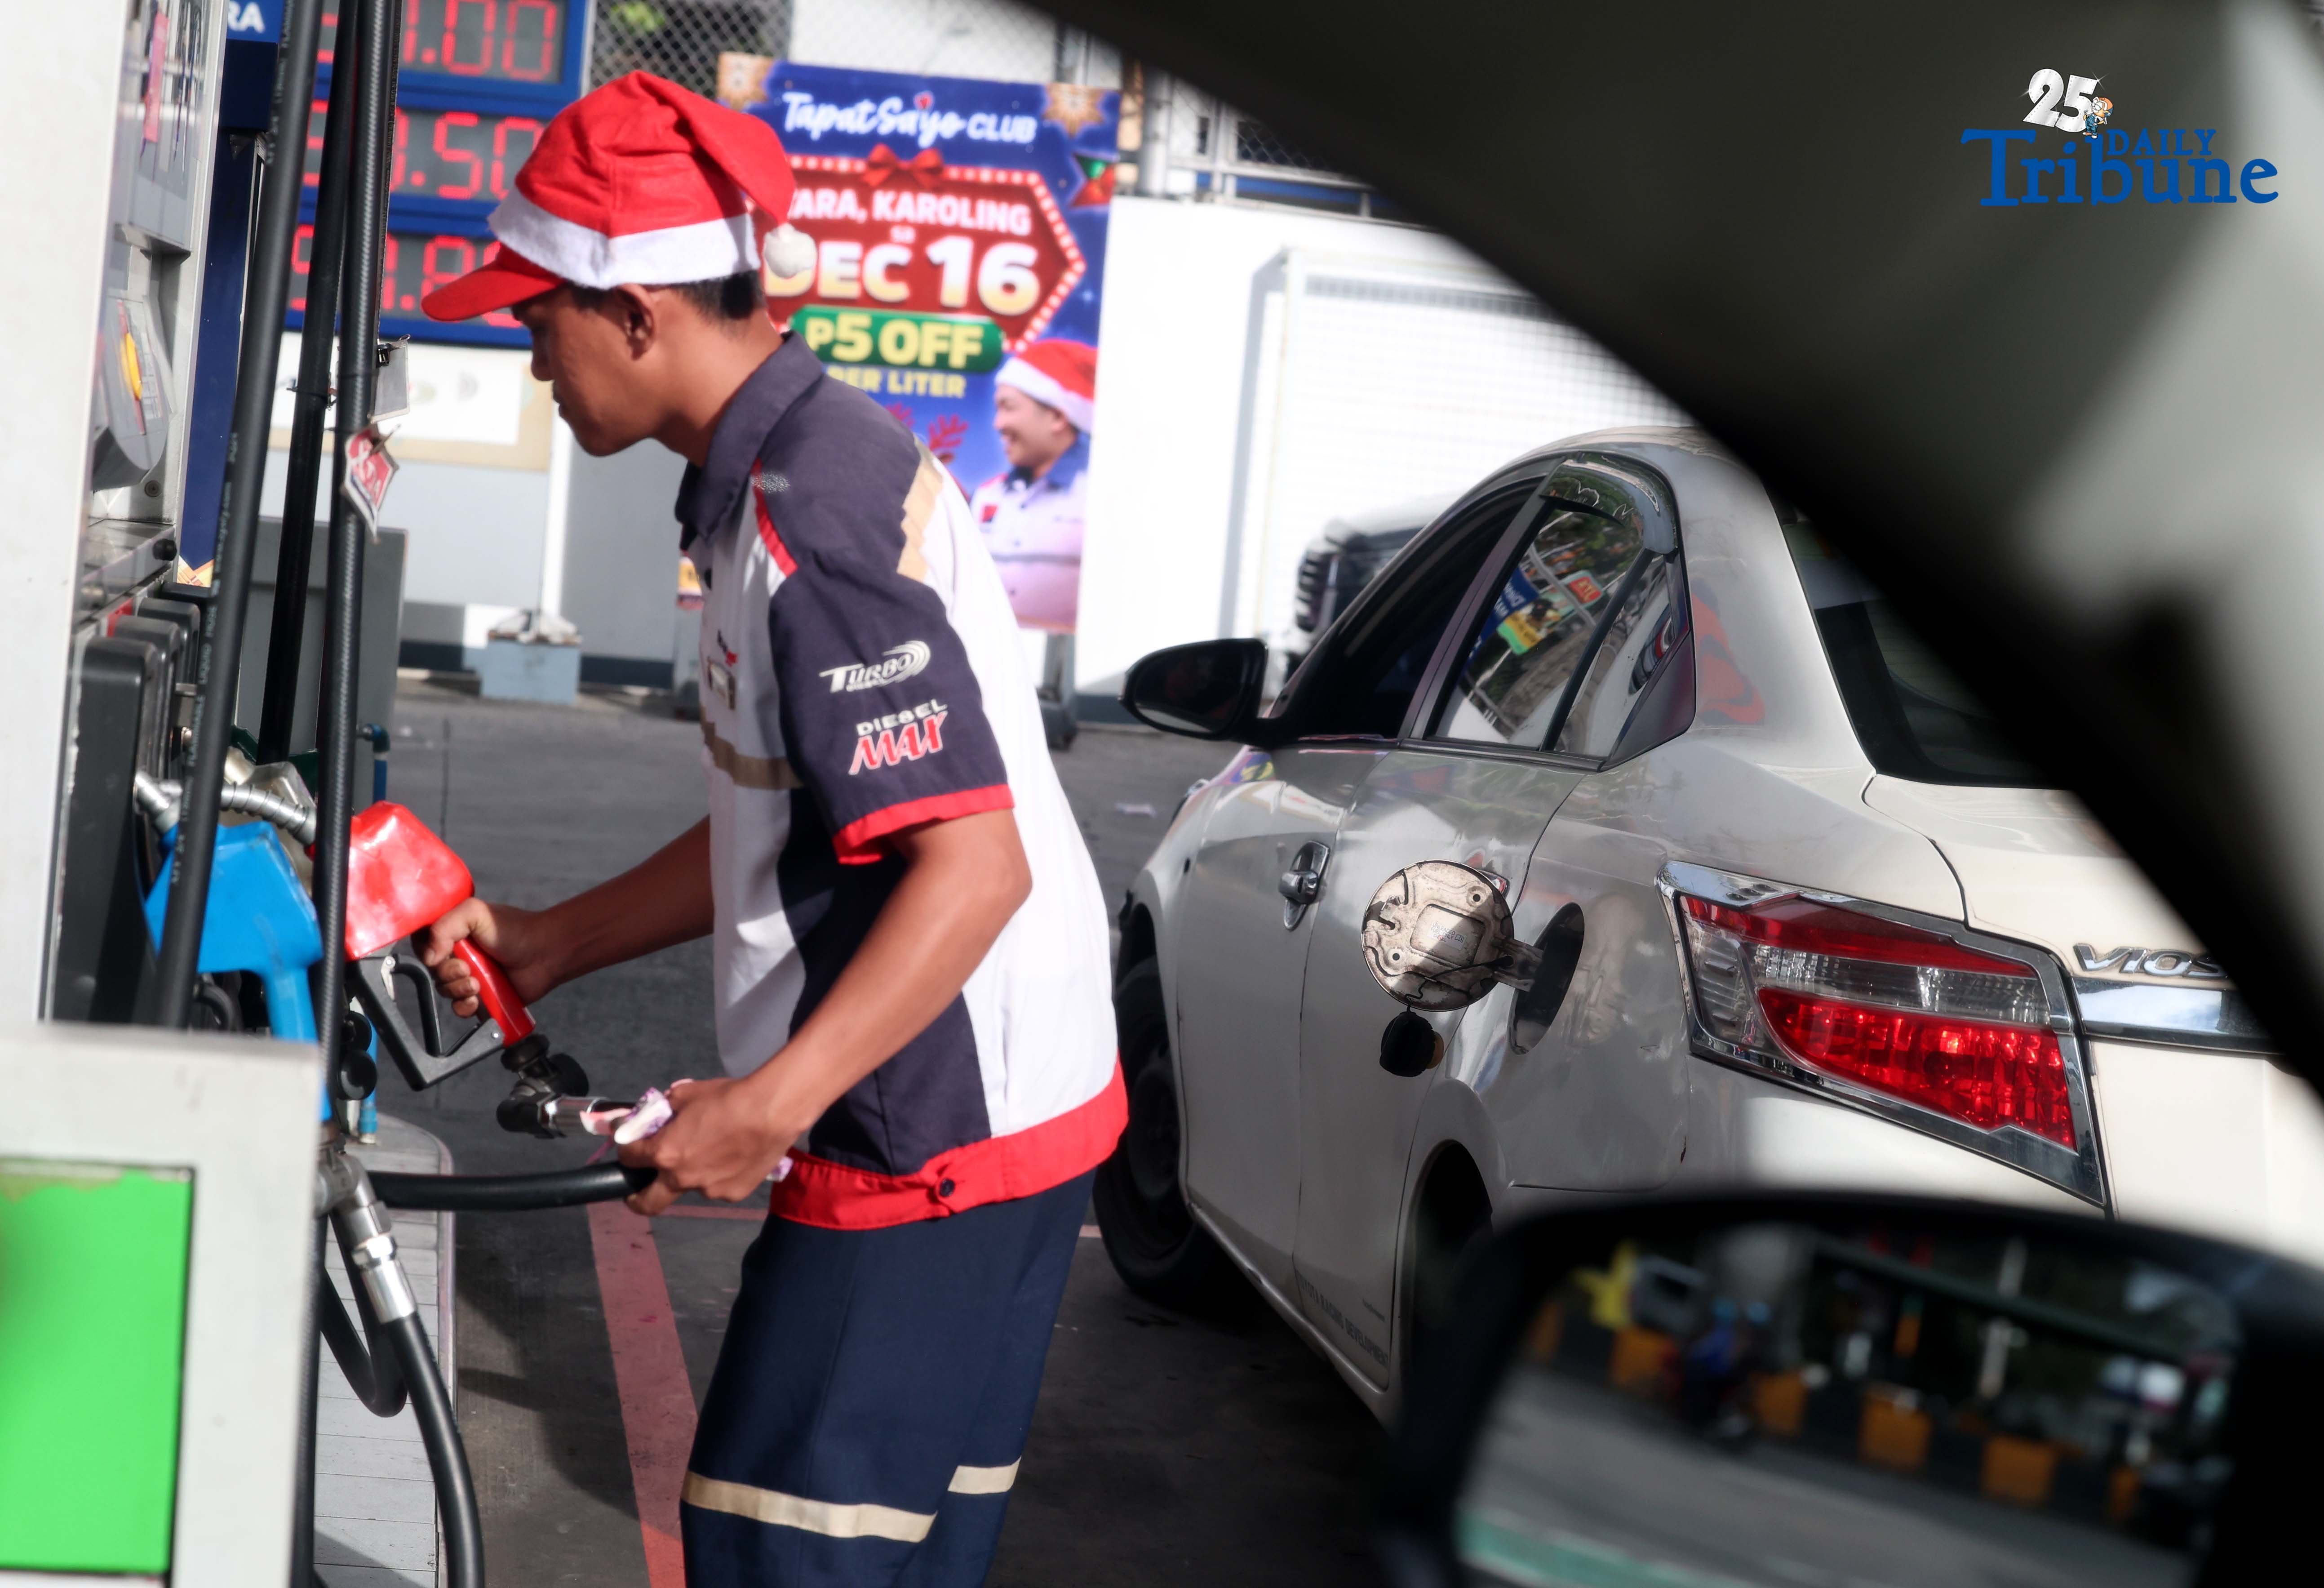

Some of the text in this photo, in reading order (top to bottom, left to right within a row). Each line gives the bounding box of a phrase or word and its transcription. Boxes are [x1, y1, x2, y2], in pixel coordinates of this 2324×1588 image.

[966, 111, 1038, 144] CLUB
[789, 188, 1033, 236] ARA, KAROLING
[925, 235, 1041, 316] 16
[805, 312, 984, 369] P5 OFF
[887, 369, 967, 399] LITER
[819, 650, 920, 693] TURBO
[856, 699, 948, 736] DIESEL
[849, 711, 948, 775] MAX
[2072, 943, 2227, 979] VIOS
